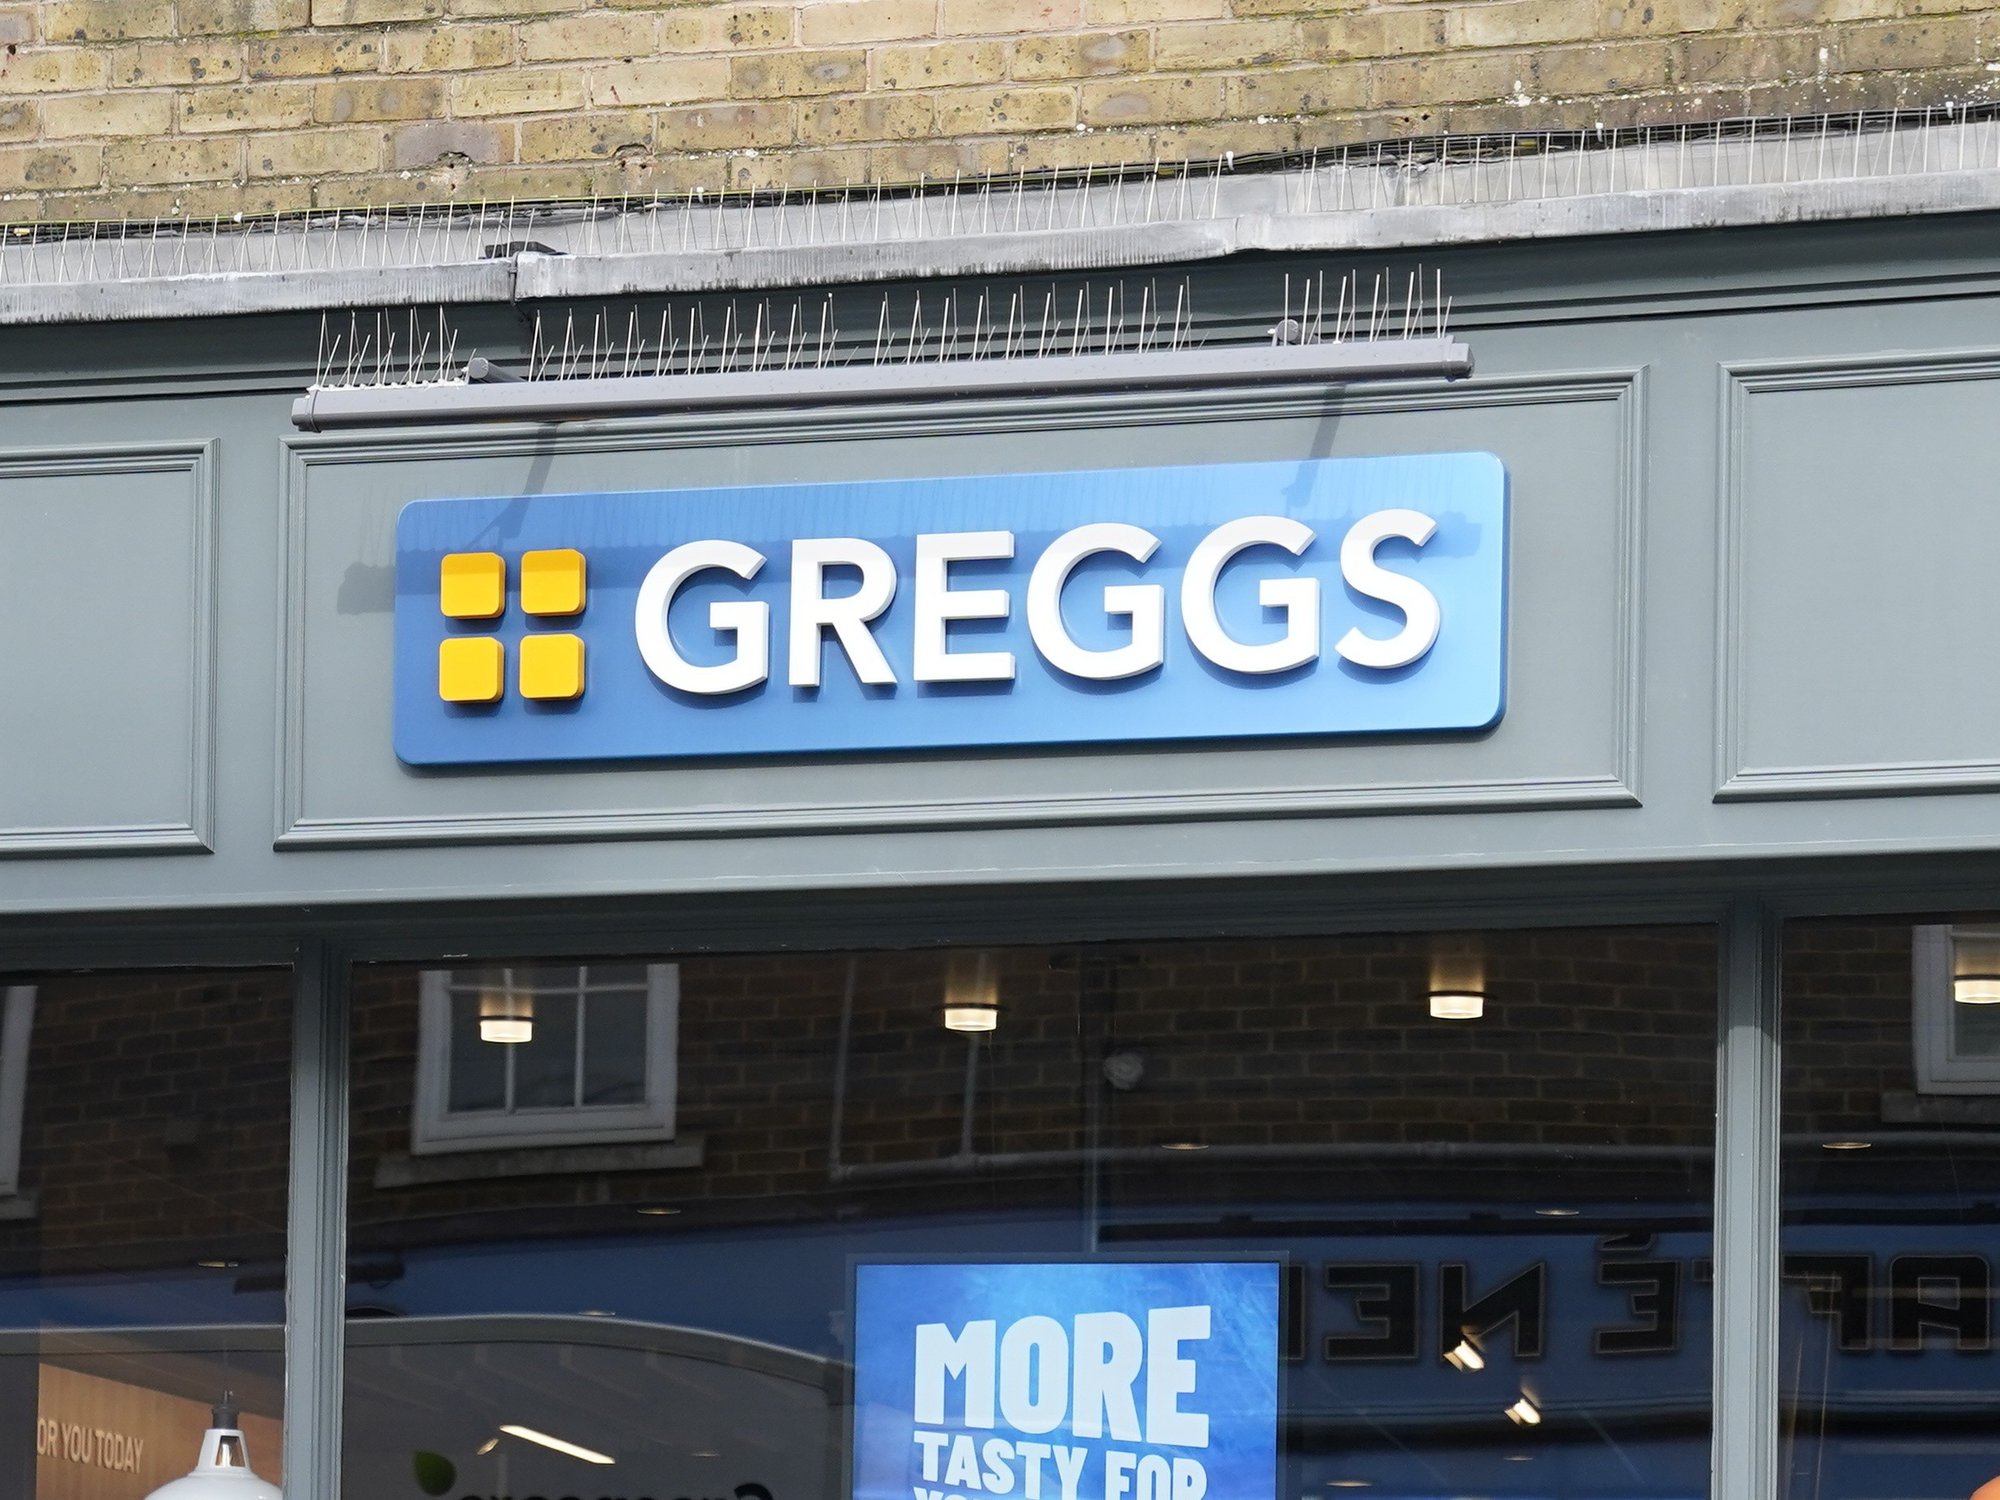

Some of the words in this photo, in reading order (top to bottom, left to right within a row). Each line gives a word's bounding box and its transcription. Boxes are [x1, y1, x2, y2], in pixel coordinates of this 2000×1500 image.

[634, 508, 1441, 695] GREGGS
[914, 1305, 1211, 1448] MORE
[61, 1423, 93, 1464] YOU
[95, 1429, 144, 1474] TODAY
[913, 1430, 1088, 1500] TASTY
[1106, 1450, 1207, 1500] FOR
